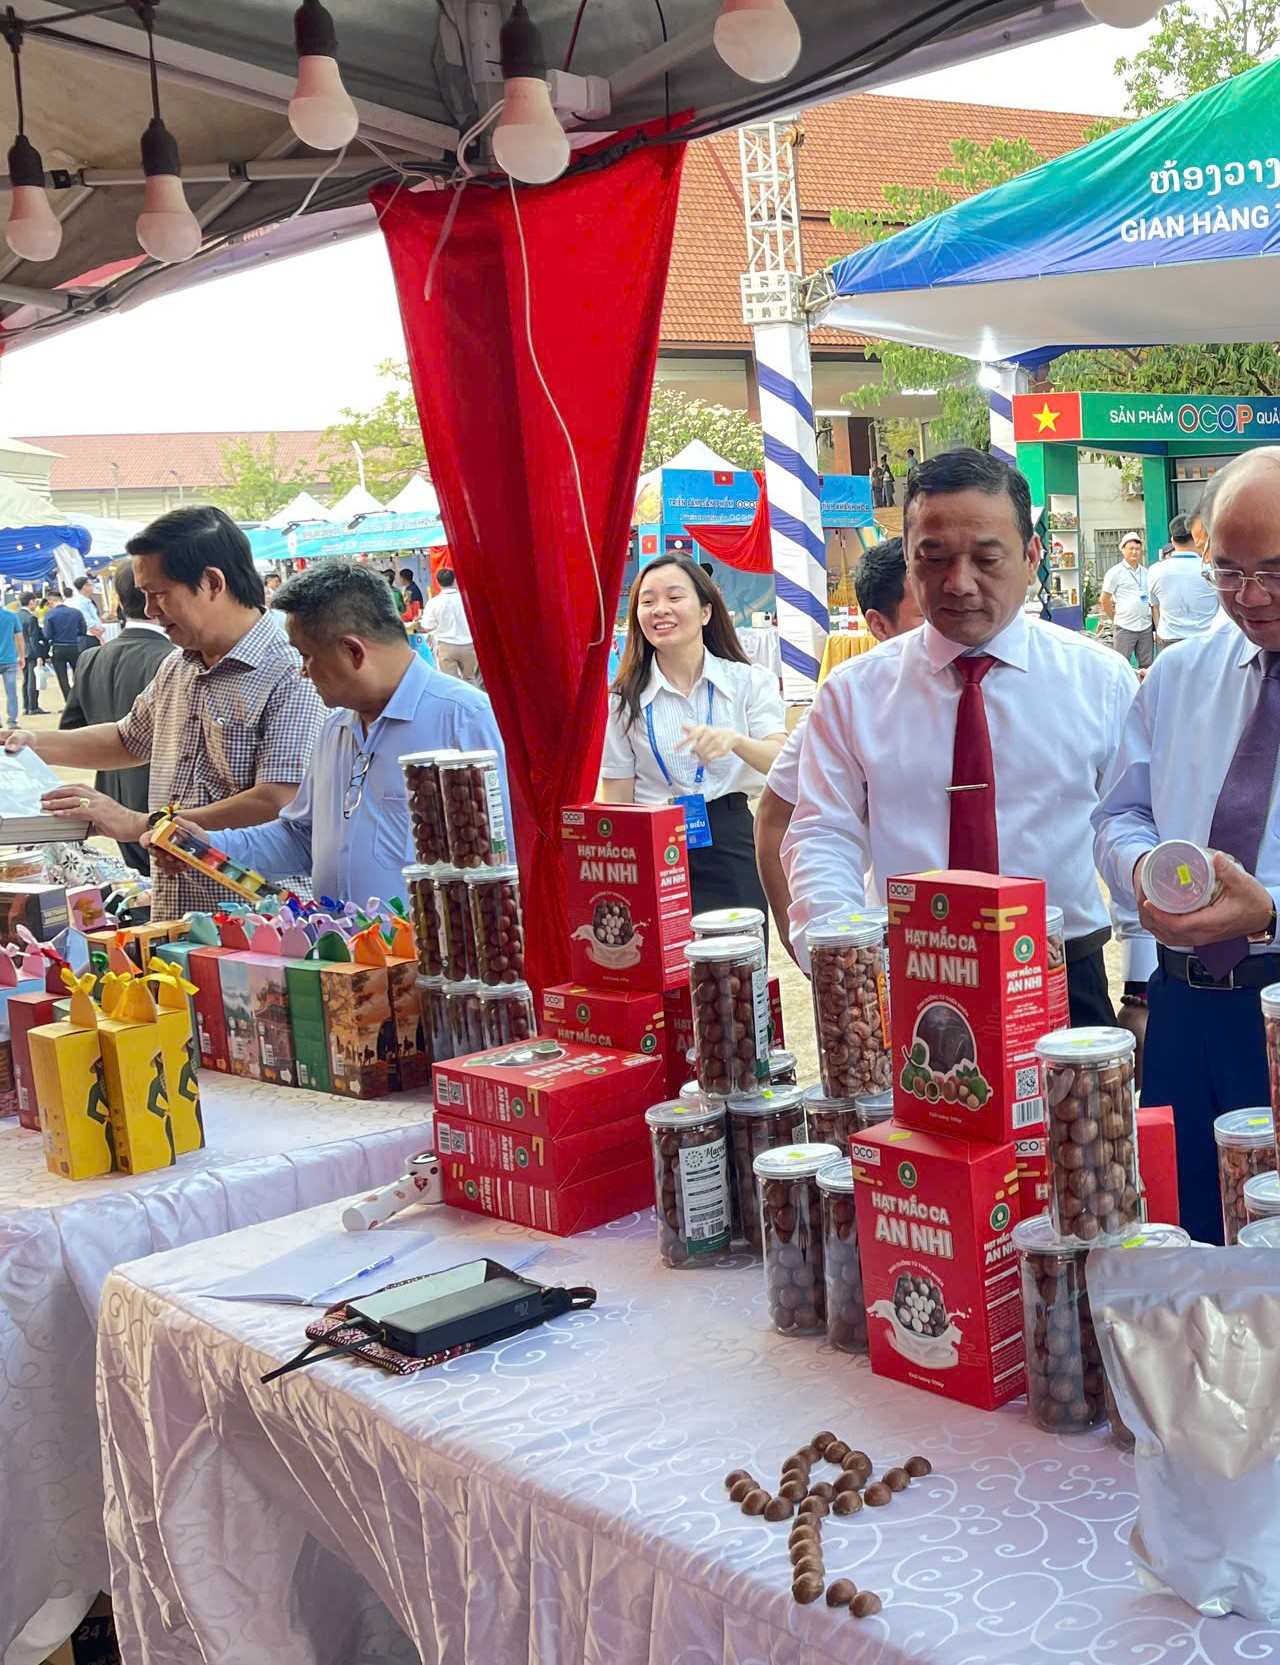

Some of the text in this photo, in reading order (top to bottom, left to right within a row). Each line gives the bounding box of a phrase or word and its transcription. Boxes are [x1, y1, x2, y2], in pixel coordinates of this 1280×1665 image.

[1120, 216, 1185, 243] GIAN
[1193, 205, 1270, 235] HÀNG
[1110, 405, 1135, 424] SẢN
[1140, 404, 1173, 424] PHẨM
[1178, 403, 1253, 433] OCOP
[736, 499, 758, 510] OCO
[577, 841, 636, 860] HẠT MẮC CA
[579, 861, 639, 884] AN NHI
[661, 873, 686, 887] AN NHI
[890, 884, 914, 896] OCOP
[905, 926, 977, 952] HẠT MẮC CA
[906, 951, 980, 988] AN NHI
[1007, 974, 1042, 994] AN NHI
[598, 1034, 613, 1046] CA
[854, 1146, 878, 1159] OCOP
[871, 1191, 949, 1224] HẠT MẮC CA
[875, 1214, 954, 1260] AN NHI
[985, 1249, 1001, 1266] AN
